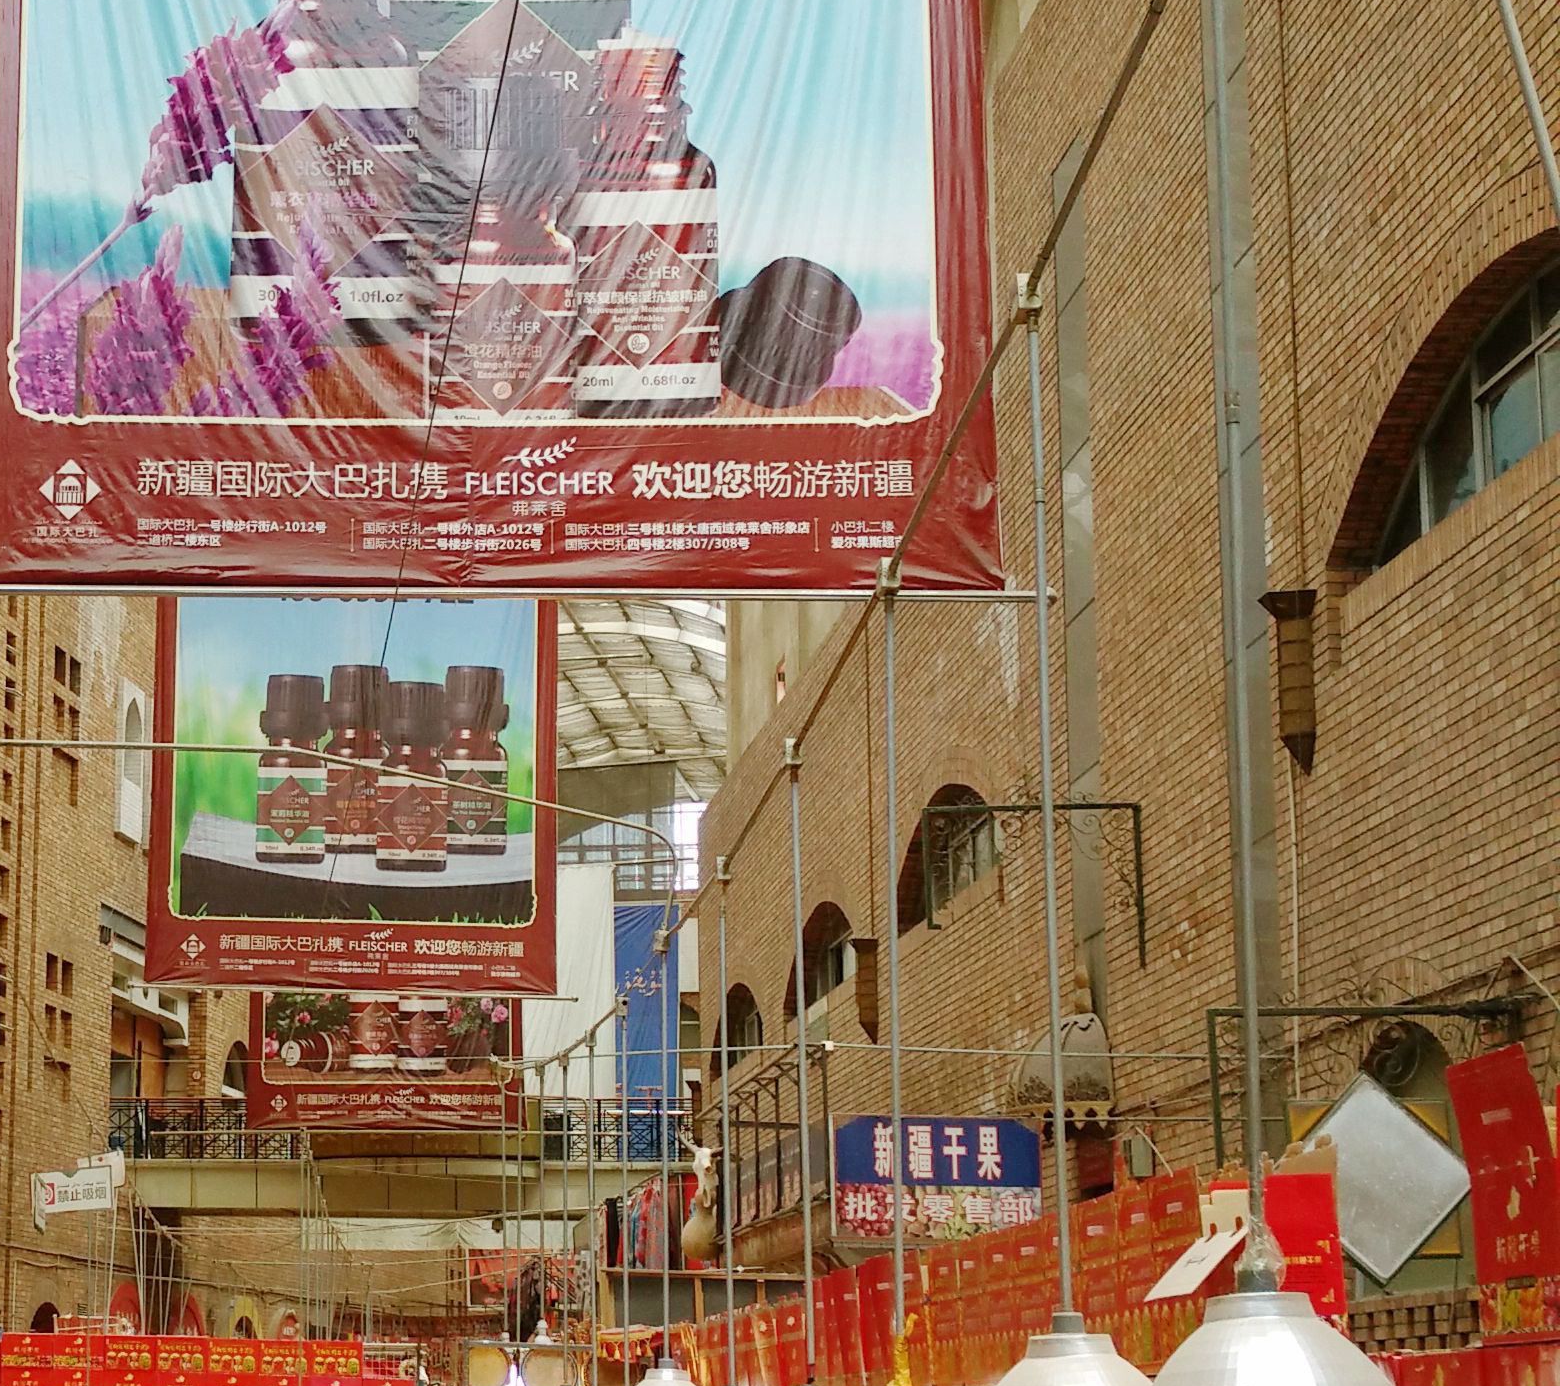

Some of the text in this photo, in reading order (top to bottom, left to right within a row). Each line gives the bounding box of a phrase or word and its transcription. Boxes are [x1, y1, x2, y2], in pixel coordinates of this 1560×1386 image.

[582, 375, 696, 387] 20ml 0.68fl.oz
[137, 458, 915, 502] 新疆国际大巴扎携 FLEISCHER 欢迎您畅游新疆
[511, 500, 567, 517] 弗莱舍
[349, 940, 408, 953] FLEISCHER
[413, 939, 524, 958] 欢迎您畅游新疆
[873, 1122, 1002, 1181] 新疆干果
[57, 1186, 107, 1203] 禁止吸烟
[844, 1192, 1034, 1225] 批发零售部
